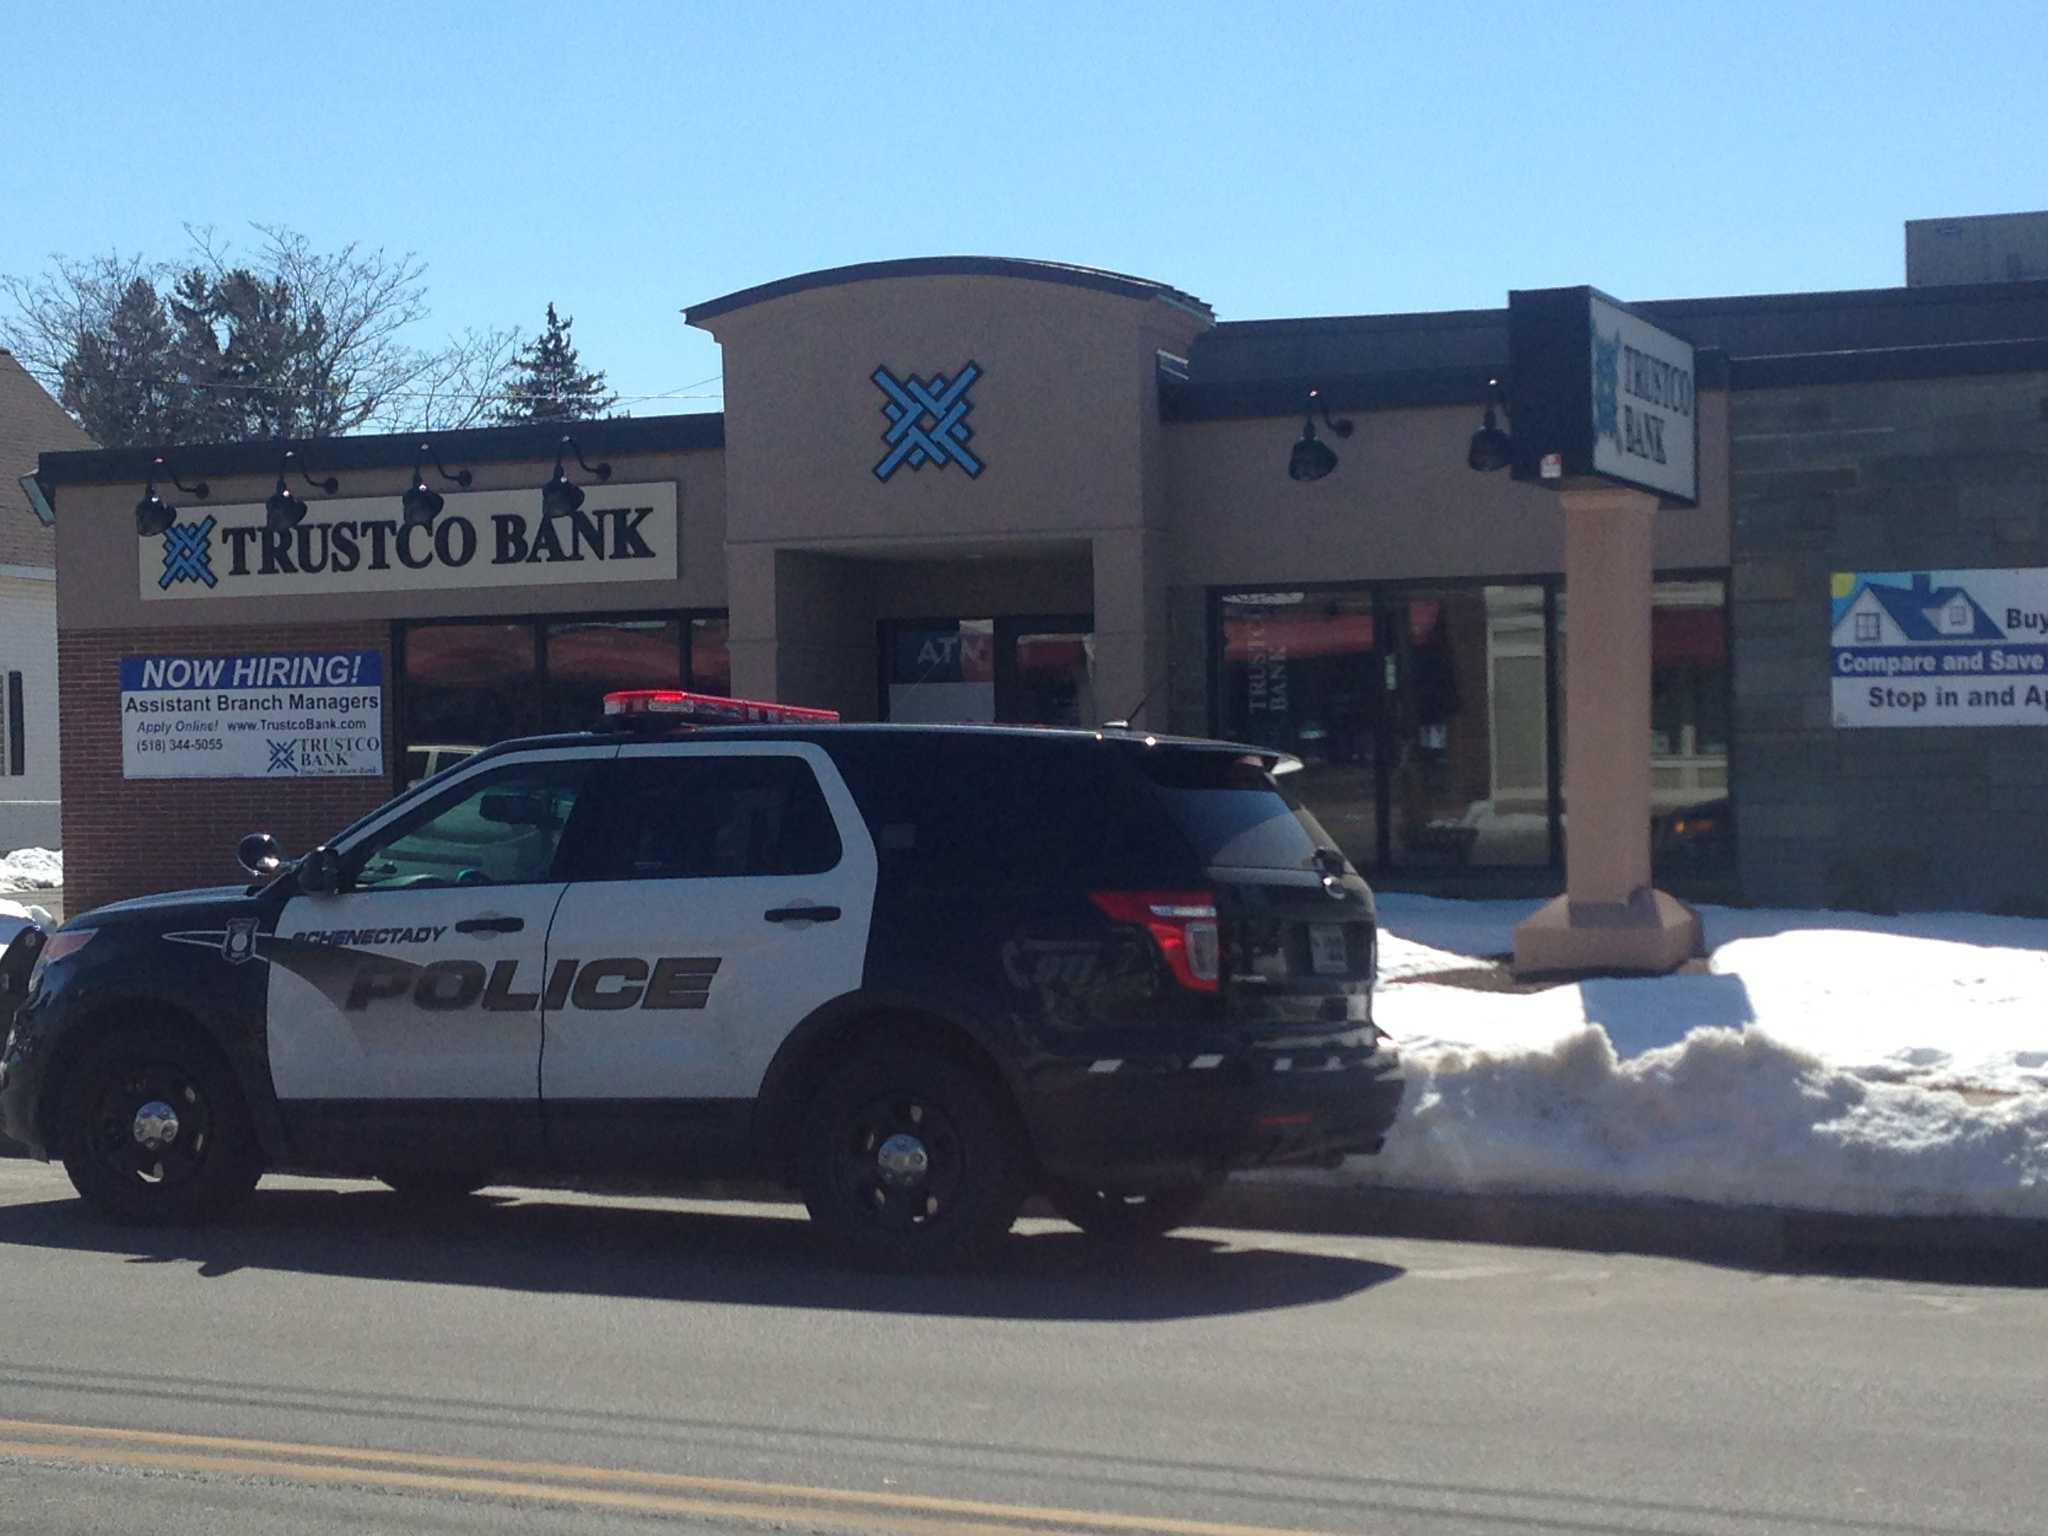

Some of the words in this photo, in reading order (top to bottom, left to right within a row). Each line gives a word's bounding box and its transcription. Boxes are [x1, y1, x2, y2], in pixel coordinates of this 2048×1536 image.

[1623, 345, 1690, 418] TRUSTCO
[1624, 404, 1667, 465] BANK
[222, 516, 477, 576] TRUSTCO
[491, 507, 656, 565] BANK
[2006, 608, 2048, 634] Buy
[141, 660, 225, 689] NOW
[232, 655, 362, 687] HIRING!
[1838, 652, 1936, 678] Compare
[1943, 651, 1983, 672] and
[1990, 650, 2045, 671] Save
[125, 697, 211, 714] Assistant
[217, 694, 283, 713] Branch
[289, 694, 379, 714] Managers
[1869, 687, 1927, 711] Stop
[1936, 686, 1958, 707] in
[1968, 685, 2015, 707] and
[136, 721, 172, 735] Apply
[175, 720, 219, 733] Online!
[227, 719, 367, 731] www.TrustcoBank.com
[136, 740, 166, 752] (518)
[169, 738, 223, 751] 344-5055
[301, 736, 380, 752] TRUSTCO
[301, 753, 349, 766] BANK
[345, 957, 722, 1011] POLICE
